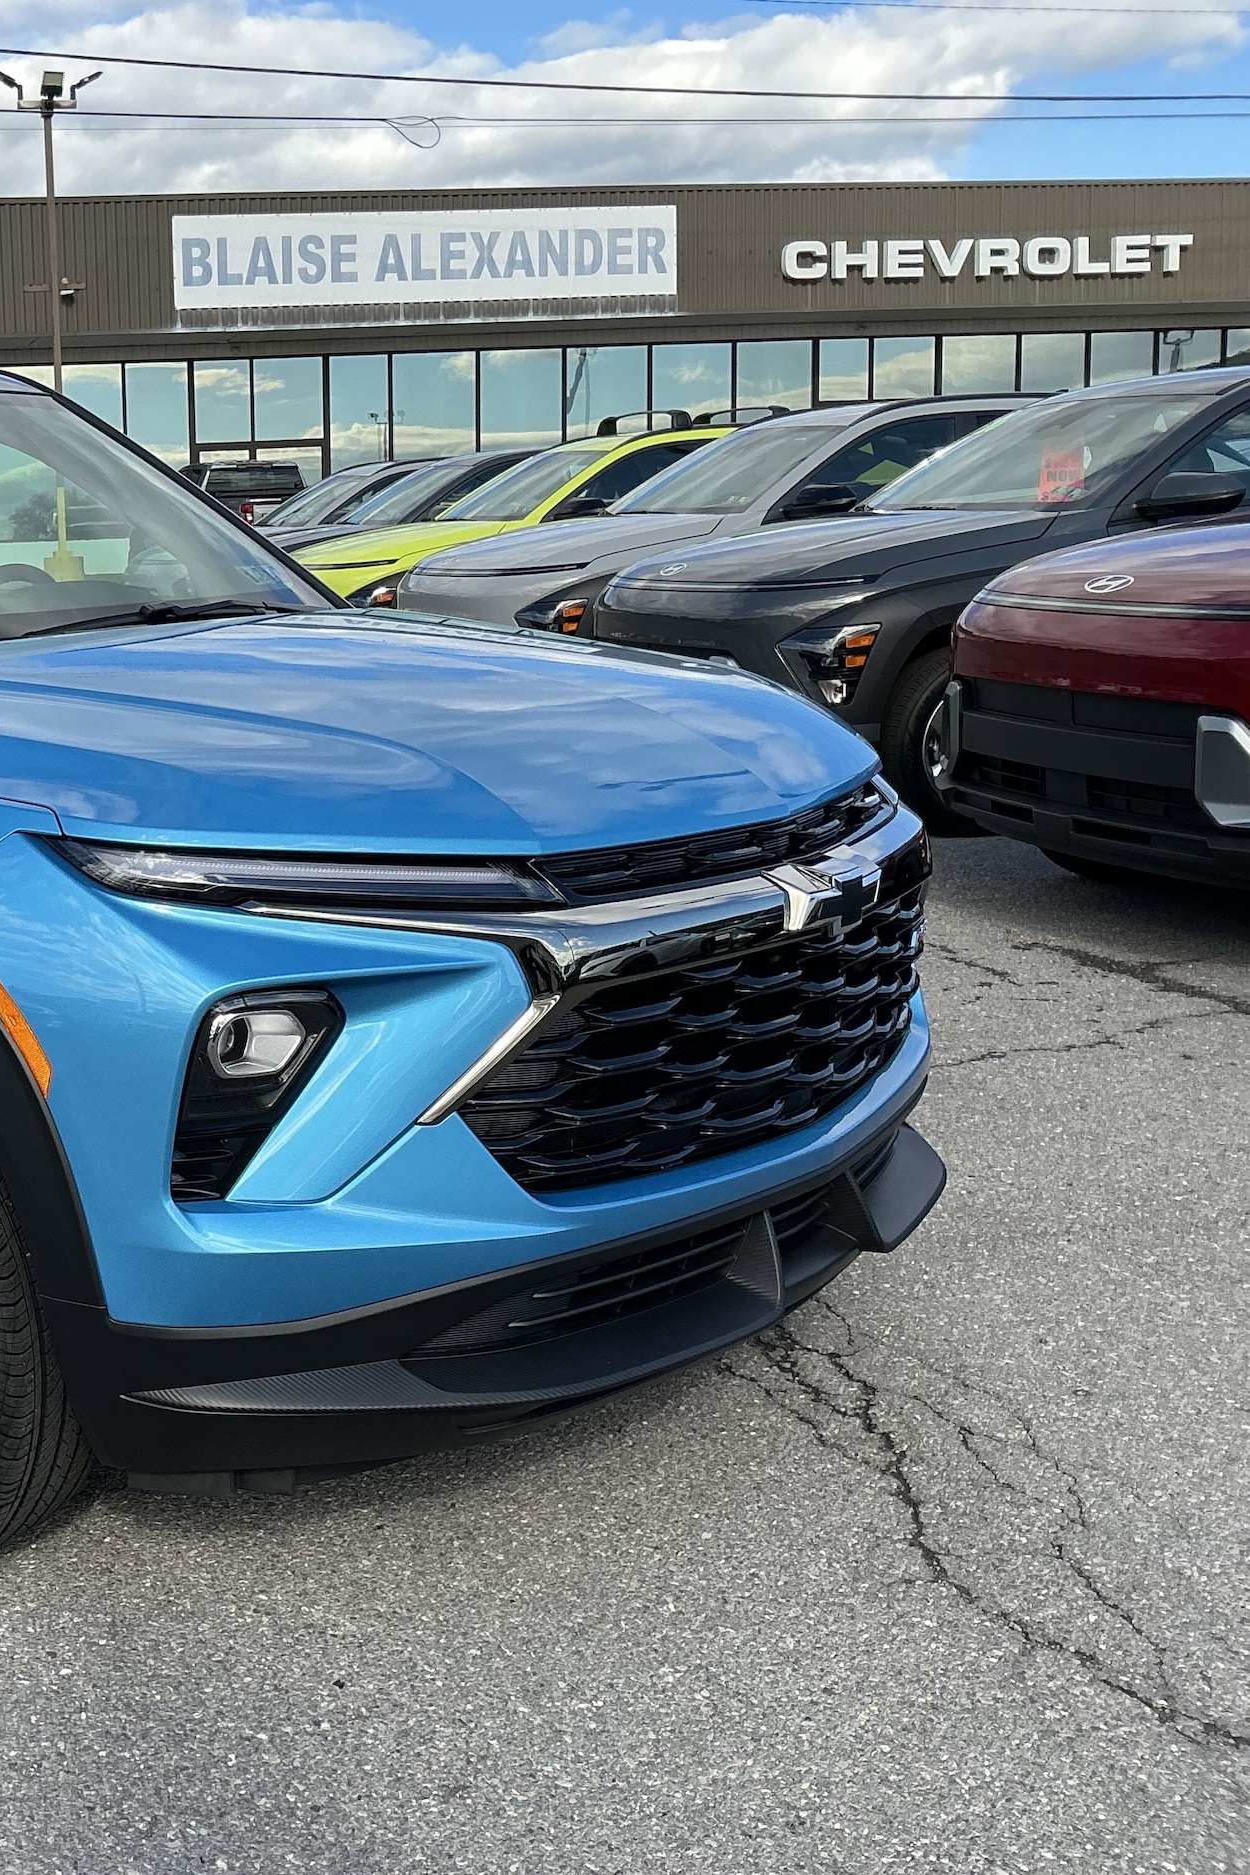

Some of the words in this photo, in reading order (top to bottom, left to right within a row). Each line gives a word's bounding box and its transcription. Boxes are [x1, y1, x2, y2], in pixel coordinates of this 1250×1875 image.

[181, 234, 358, 287] BLAISE
[375, 226, 668, 282] ALEXANDER
[781, 234, 1194, 279] CHEVROLET
